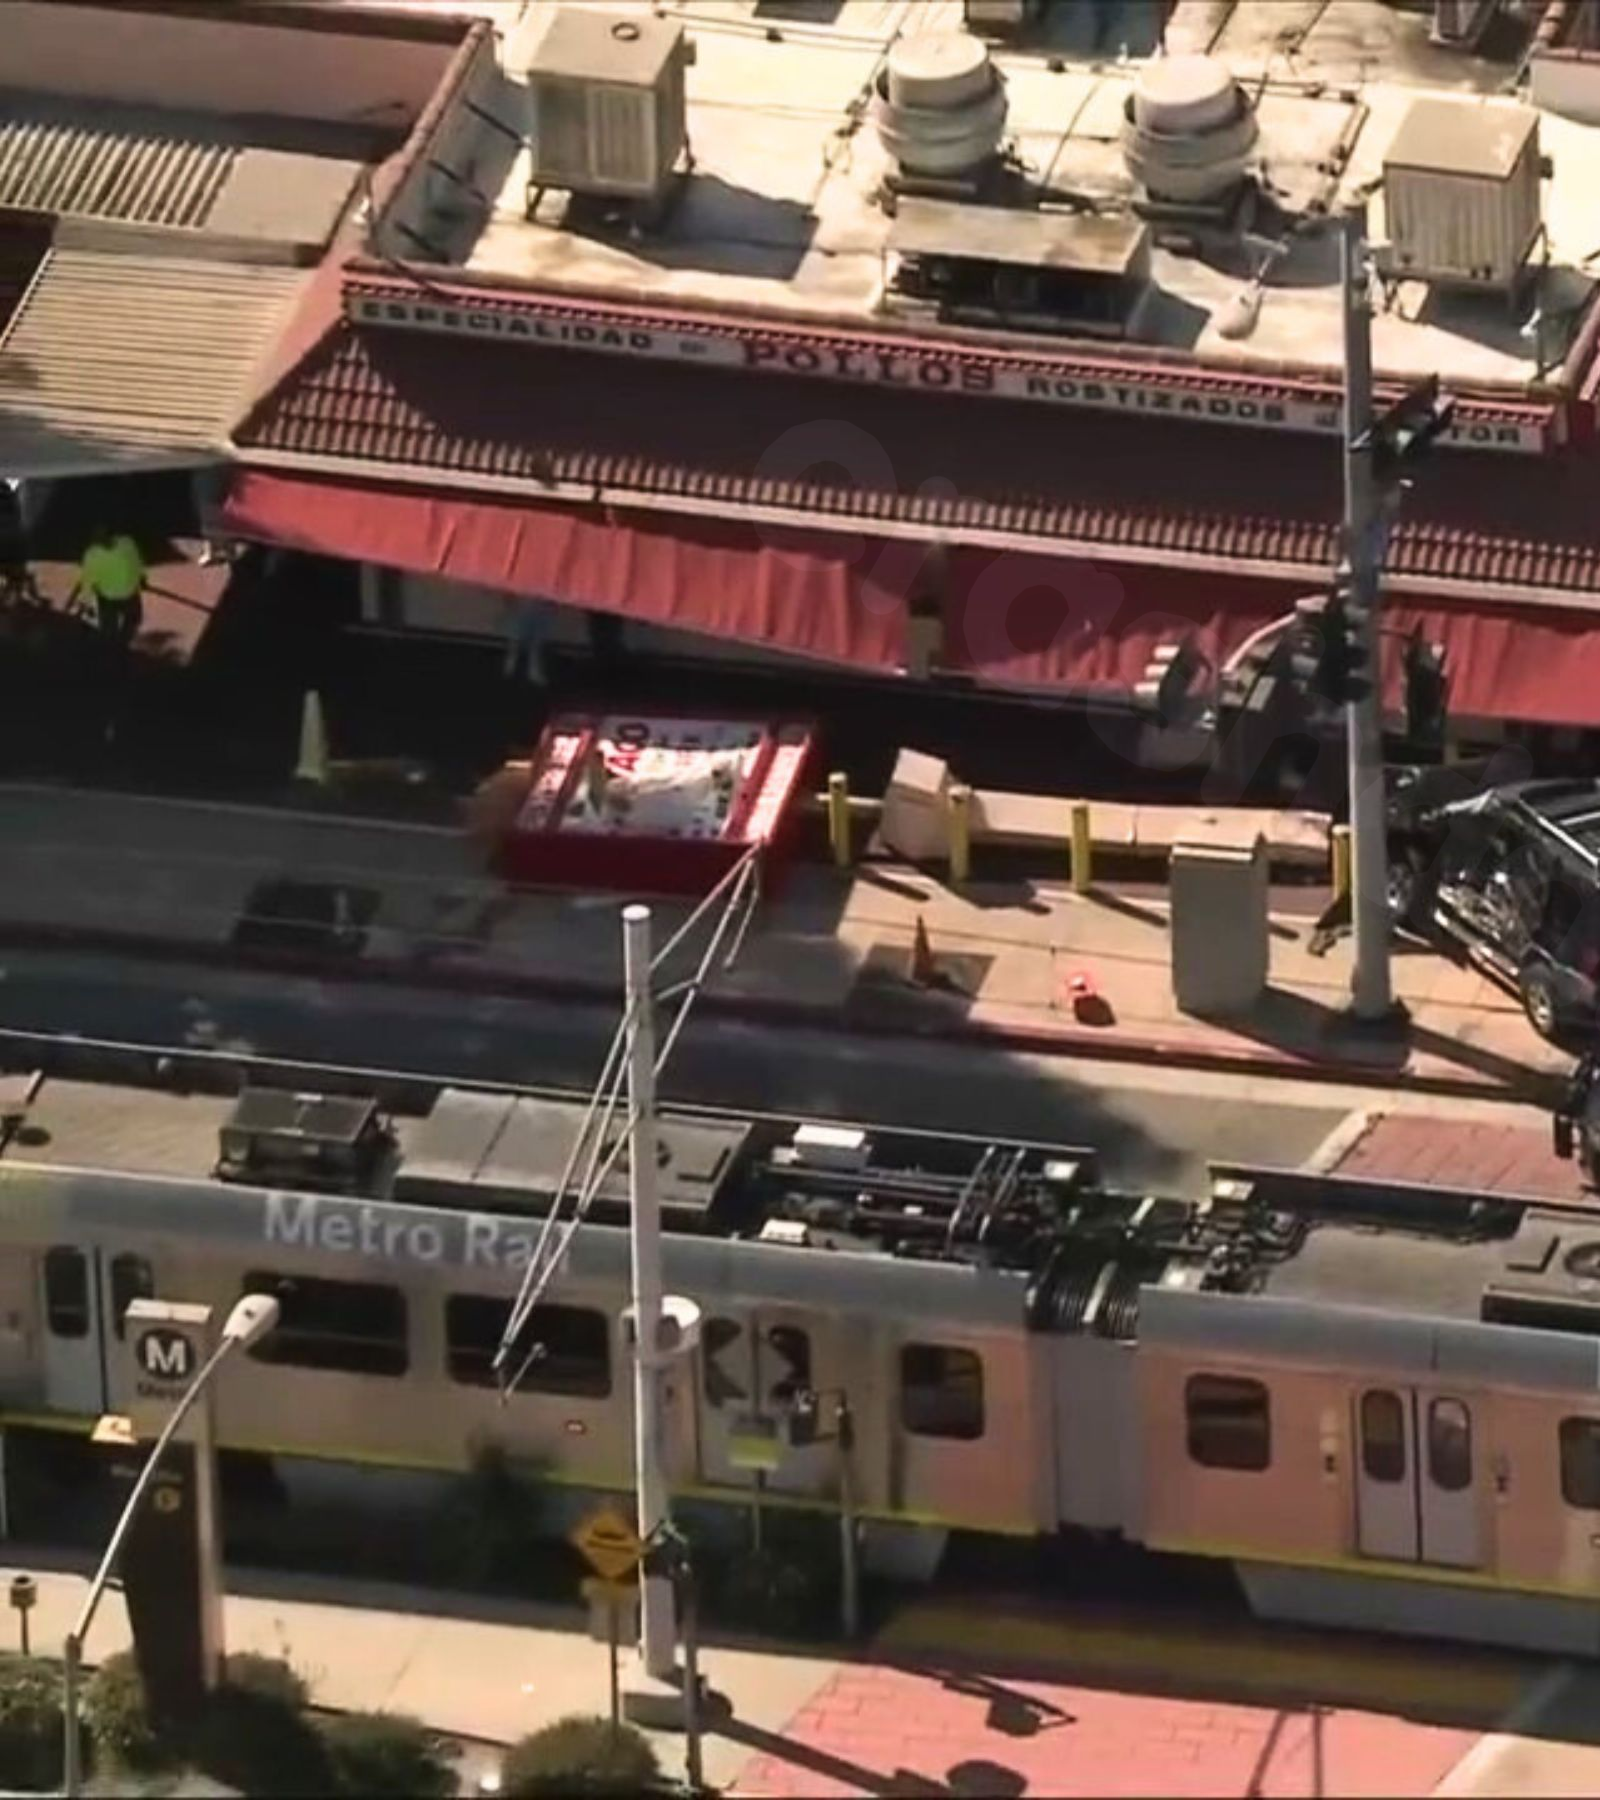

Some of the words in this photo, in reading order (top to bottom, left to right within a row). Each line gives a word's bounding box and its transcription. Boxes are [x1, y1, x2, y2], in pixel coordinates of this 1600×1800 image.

[361, 302, 652, 348] ESPECIALIDAD
[742, 338, 995, 391] POLLOS
[1026, 378, 1285, 422] ROSTIZADOS
[263, 1193, 442, 1262] Metro
[145, 1335, 187, 1374] M
